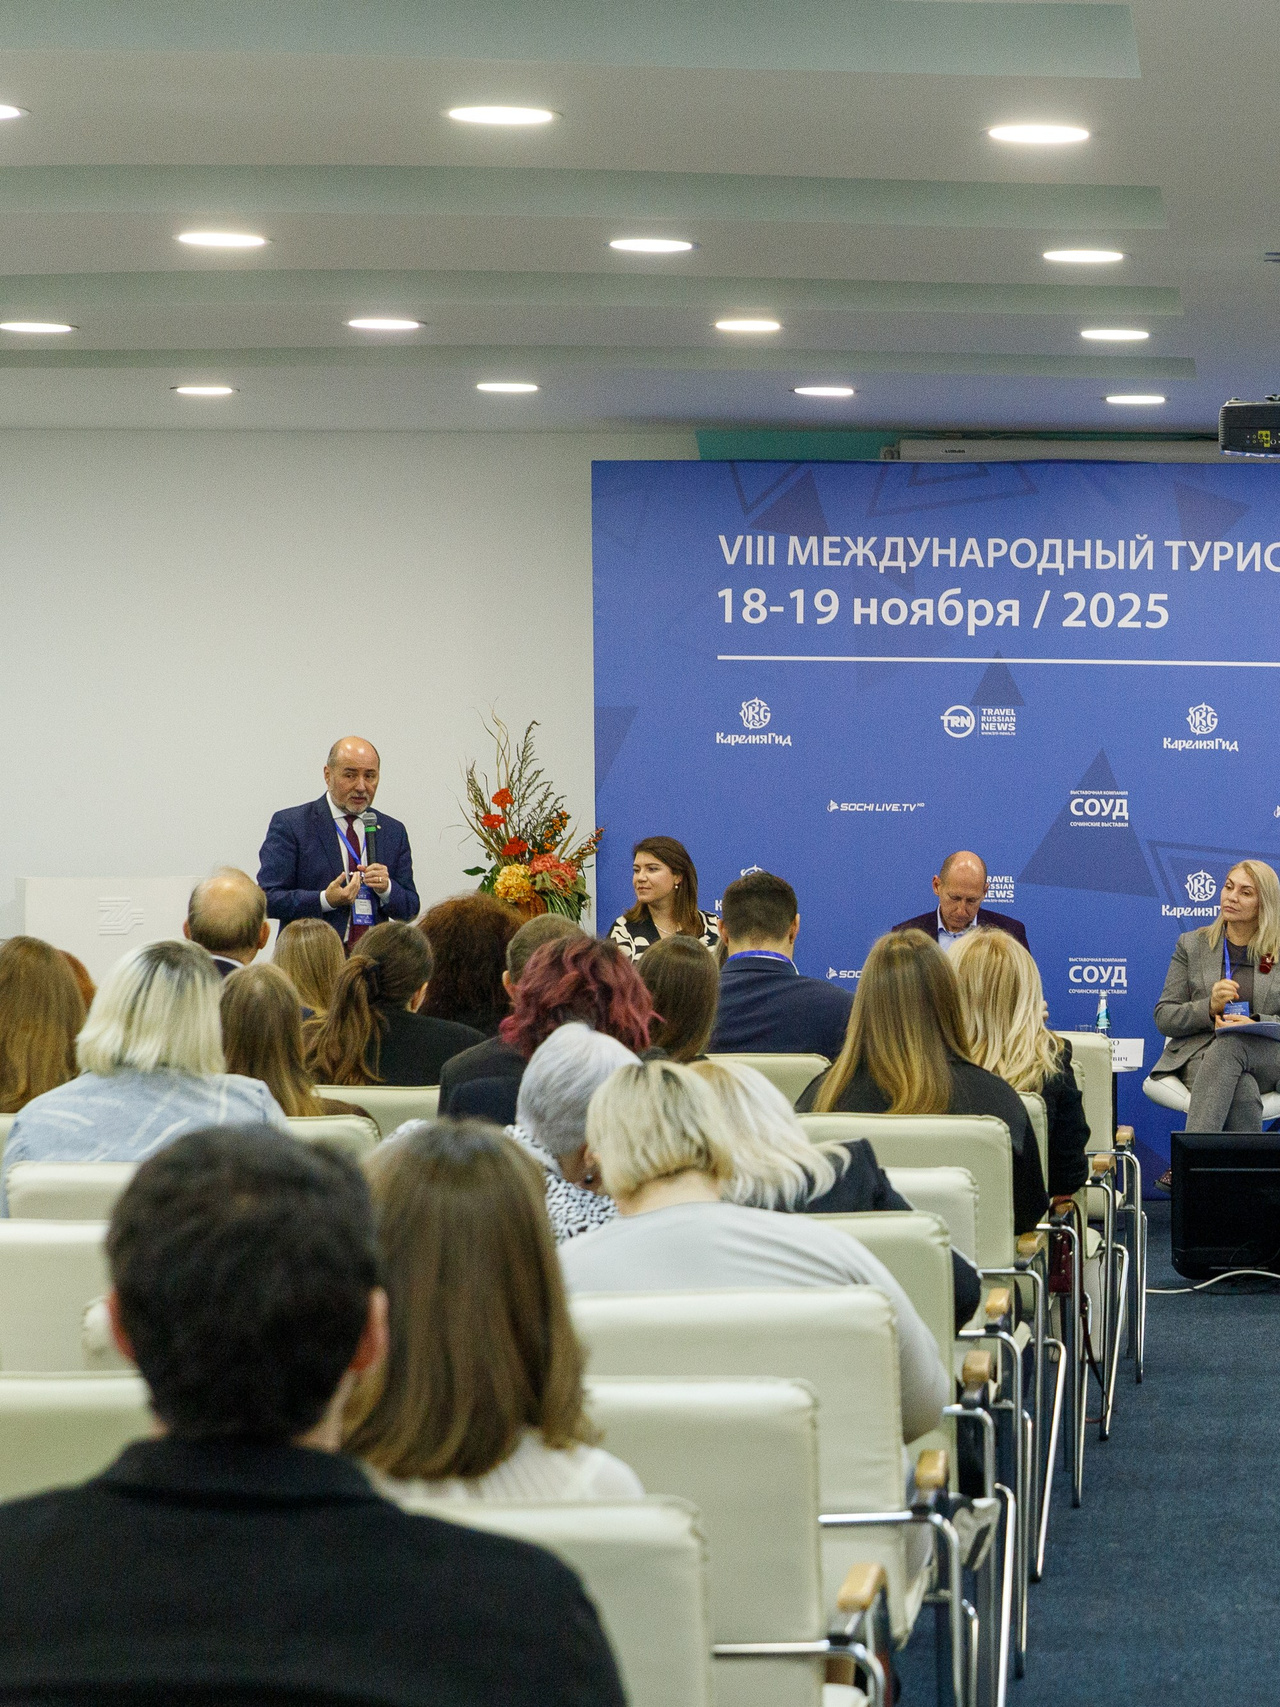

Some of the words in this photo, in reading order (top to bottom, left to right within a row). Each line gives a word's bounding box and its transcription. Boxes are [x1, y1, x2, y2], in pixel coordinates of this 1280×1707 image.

[718, 534, 775, 566] VIII
[787, 534, 1154, 575] МЕЖДУНАРОДНЫЙ
[718, 588, 839, 625] 18-19
[853, 588, 1020, 636] ноября
[1062, 592, 1169, 629] 2025
[981, 708, 1016, 716] TRAVEL
[981, 723, 1016, 731] NEWS
[716, 732, 792, 746] КарелияГид
[1163, 737, 1239, 752] КарелияГид
[840, 803, 874, 811] SOCHI
[875, 803, 917, 812] LIVE.TV
[1070, 798, 1129, 820] СОУД
[1161, 904, 1221, 918] КарелияГ
[838, 970, 862, 978] SOC
[1069, 965, 1127, 987] СОУД
